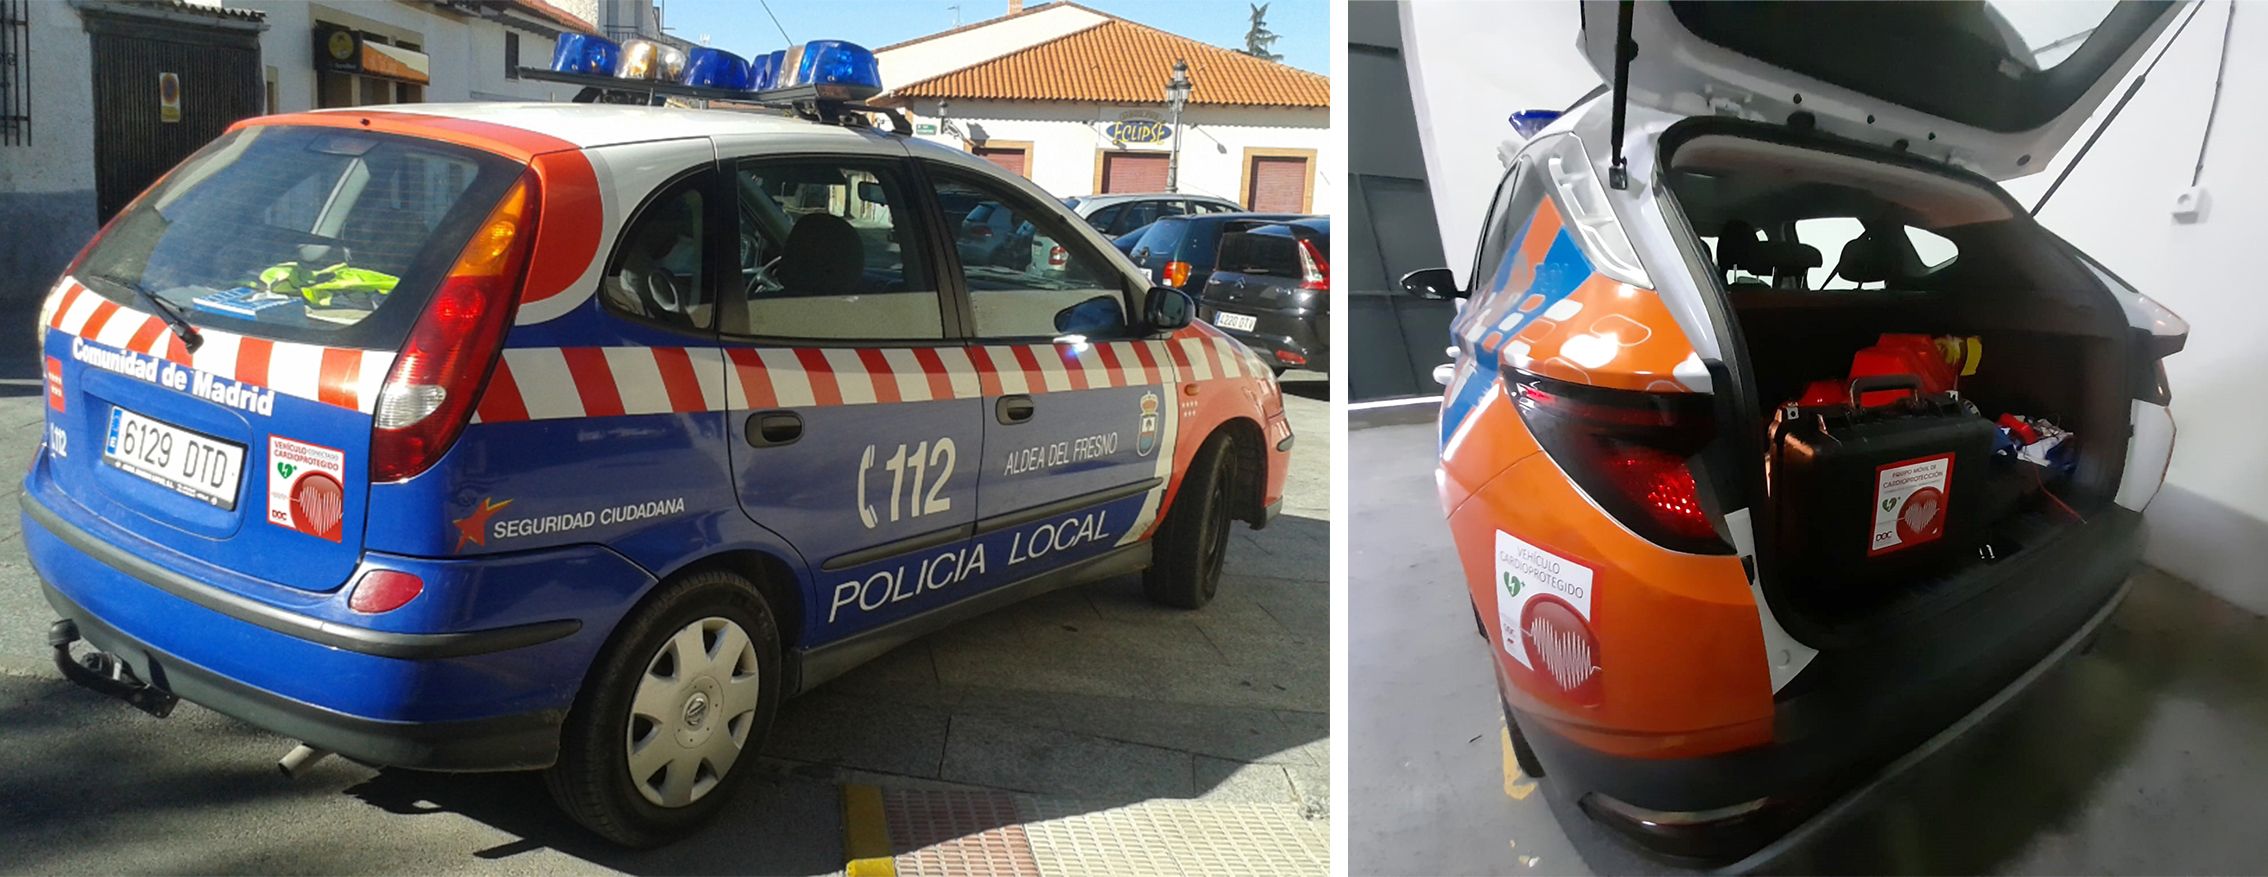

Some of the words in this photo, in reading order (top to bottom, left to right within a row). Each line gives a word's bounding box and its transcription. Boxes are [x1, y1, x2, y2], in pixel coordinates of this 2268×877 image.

[1114, 121, 1165, 145] ECLIPSE
[72, 337, 158, 382] Comunidad
[162, 361, 188, 391] de
[192, 370, 274, 416] Madrid
[123, 420, 173, 468] 6129
[183, 440, 228, 488] DTD
[273, 449, 339, 471] CARDIOPROTEGIDO
[1004, 447, 1045, 476] ALDEA
[1048, 438, 1070, 466] DEL
[1072, 432, 1118, 462] FRESNO
[886, 437, 956, 522] 112
[272, 509, 287, 521] DOC
[493, 511, 595, 539] SEGURIDAD
[599, 497, 685, 526] CIUDADANA
[1875, 531, 1893, 542] DOC
[828, 543, 986, 623] POLICIA
[1008, 510, 1110, 566] LOCAL
[1499, 551, 1584, 599] CARDIOPROTEGIDO
[1518, 547, 1560, 574] VEHÍCULO
